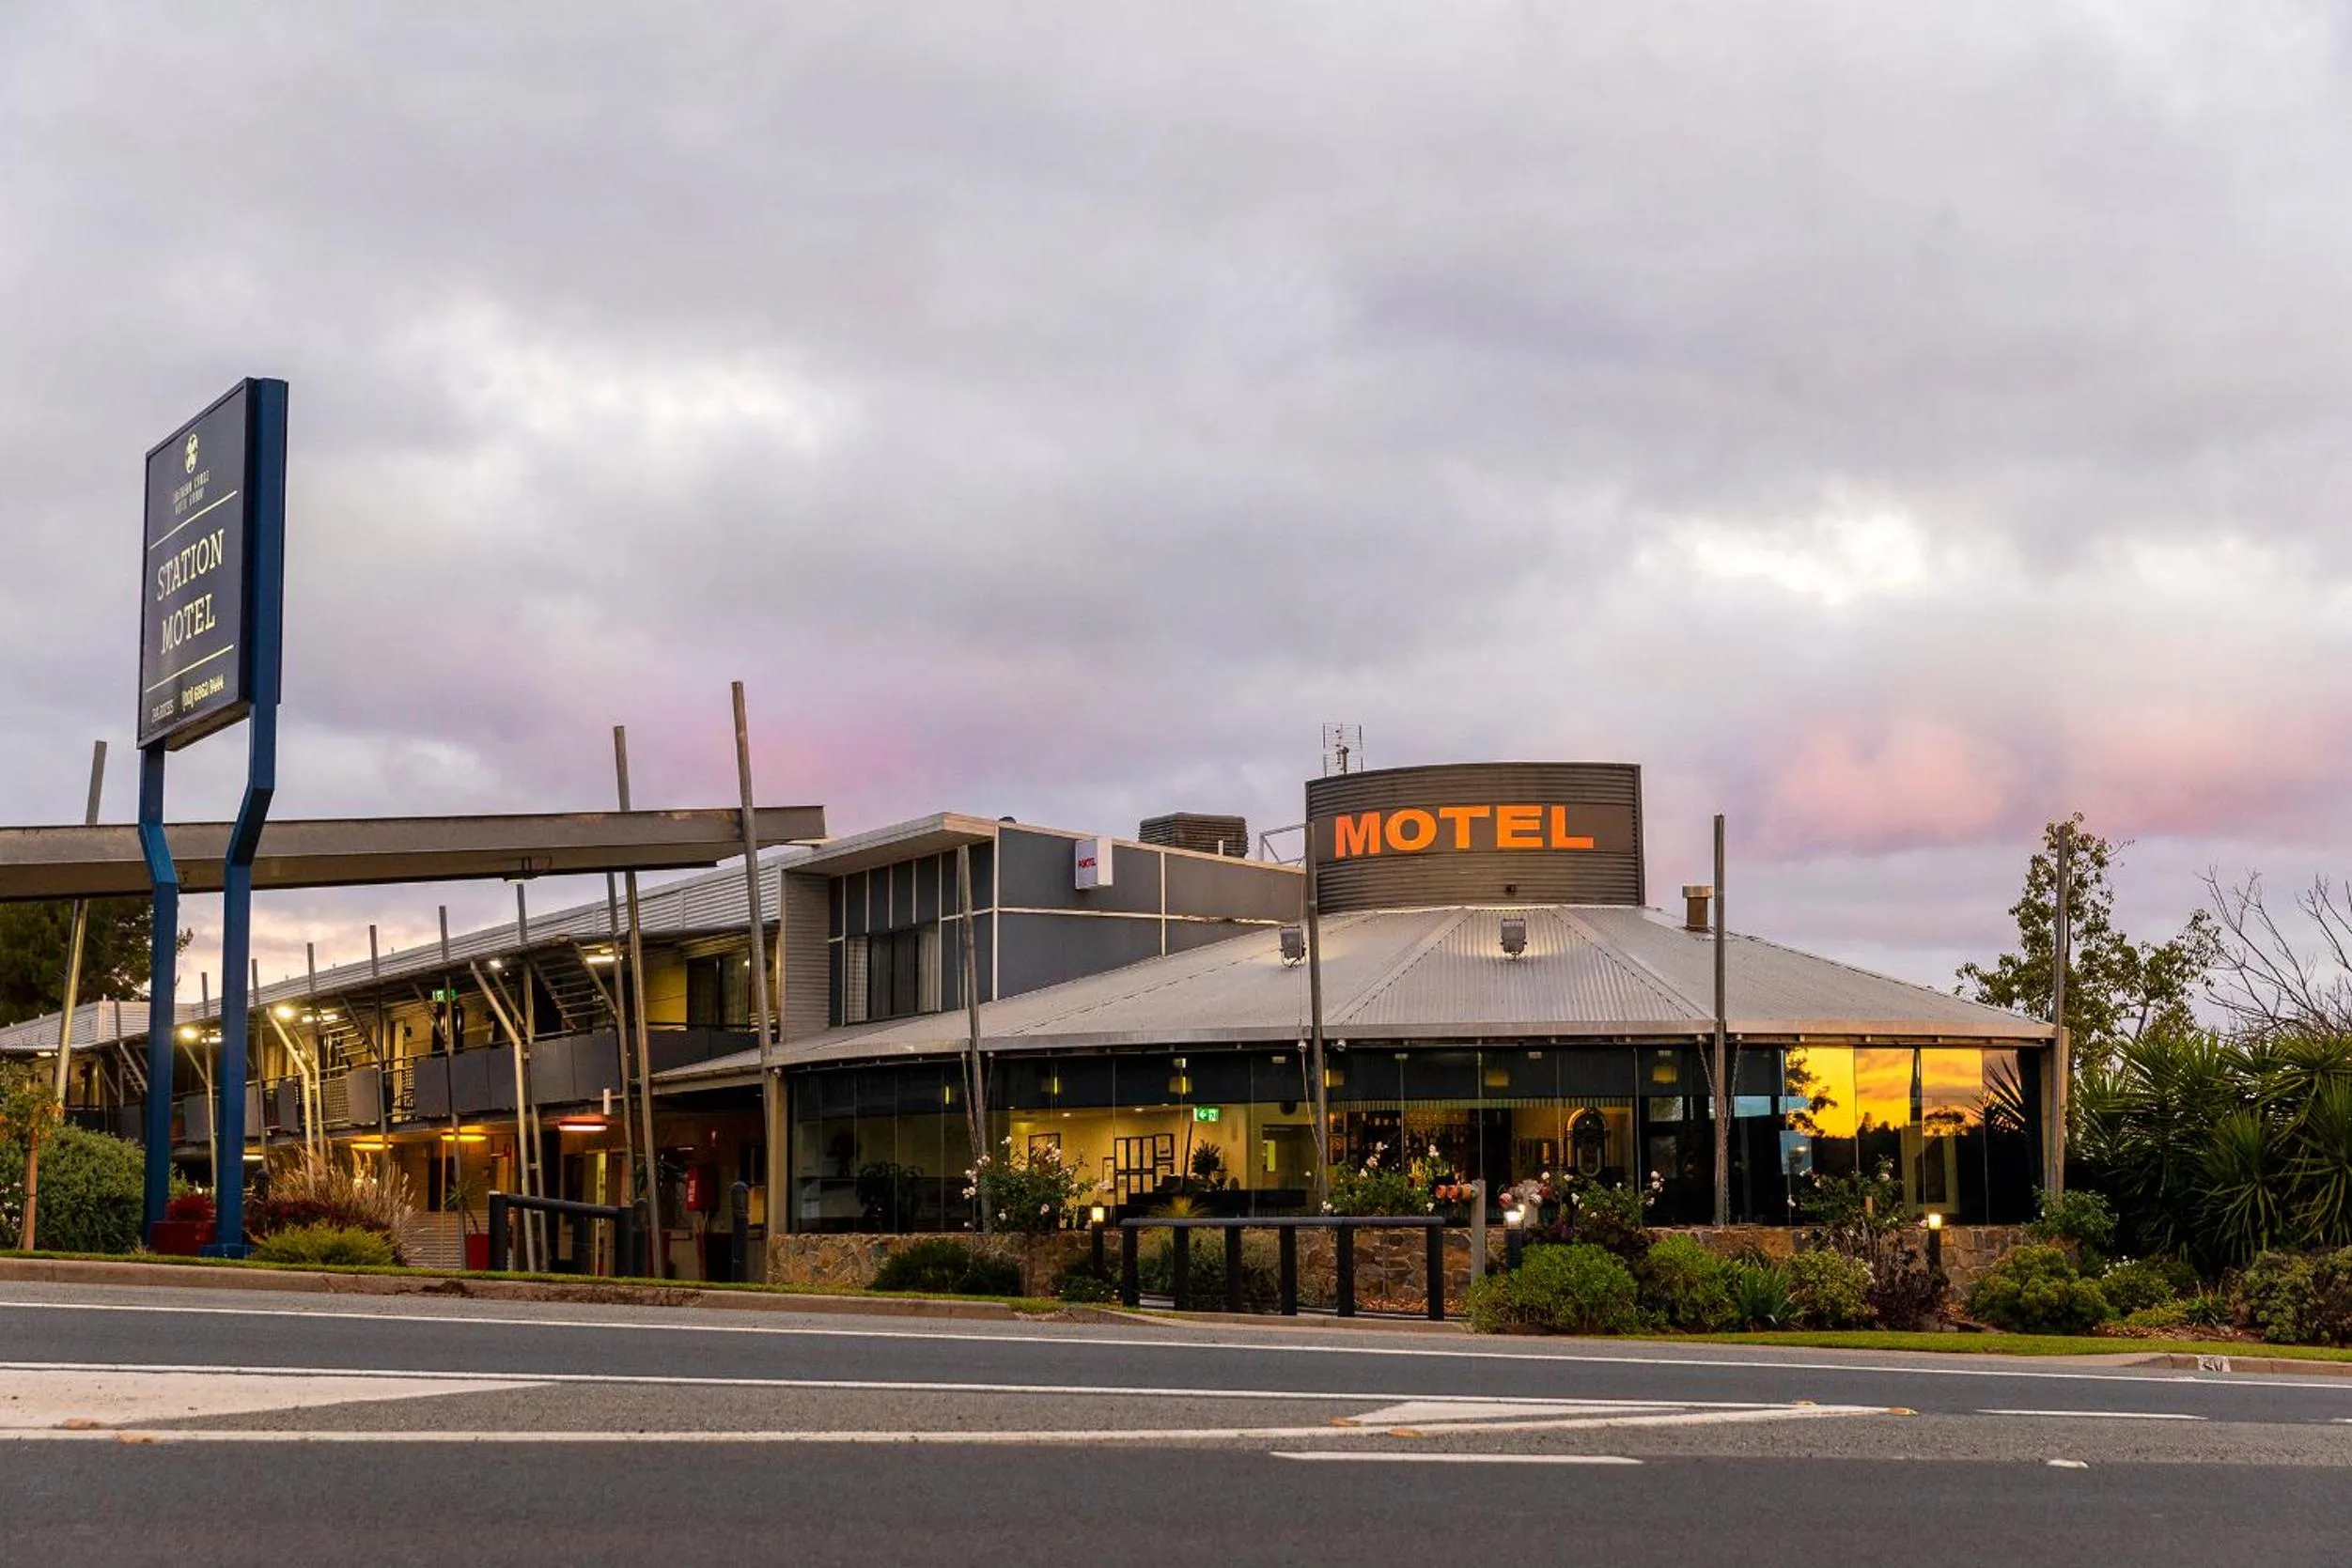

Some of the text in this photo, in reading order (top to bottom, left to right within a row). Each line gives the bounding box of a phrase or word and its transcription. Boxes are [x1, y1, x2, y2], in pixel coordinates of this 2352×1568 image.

[157, 528, 225, 601] STATION
[161, 593, 215, 655] MOTEL
[1334, 804, 1595, 860] MOTEL
